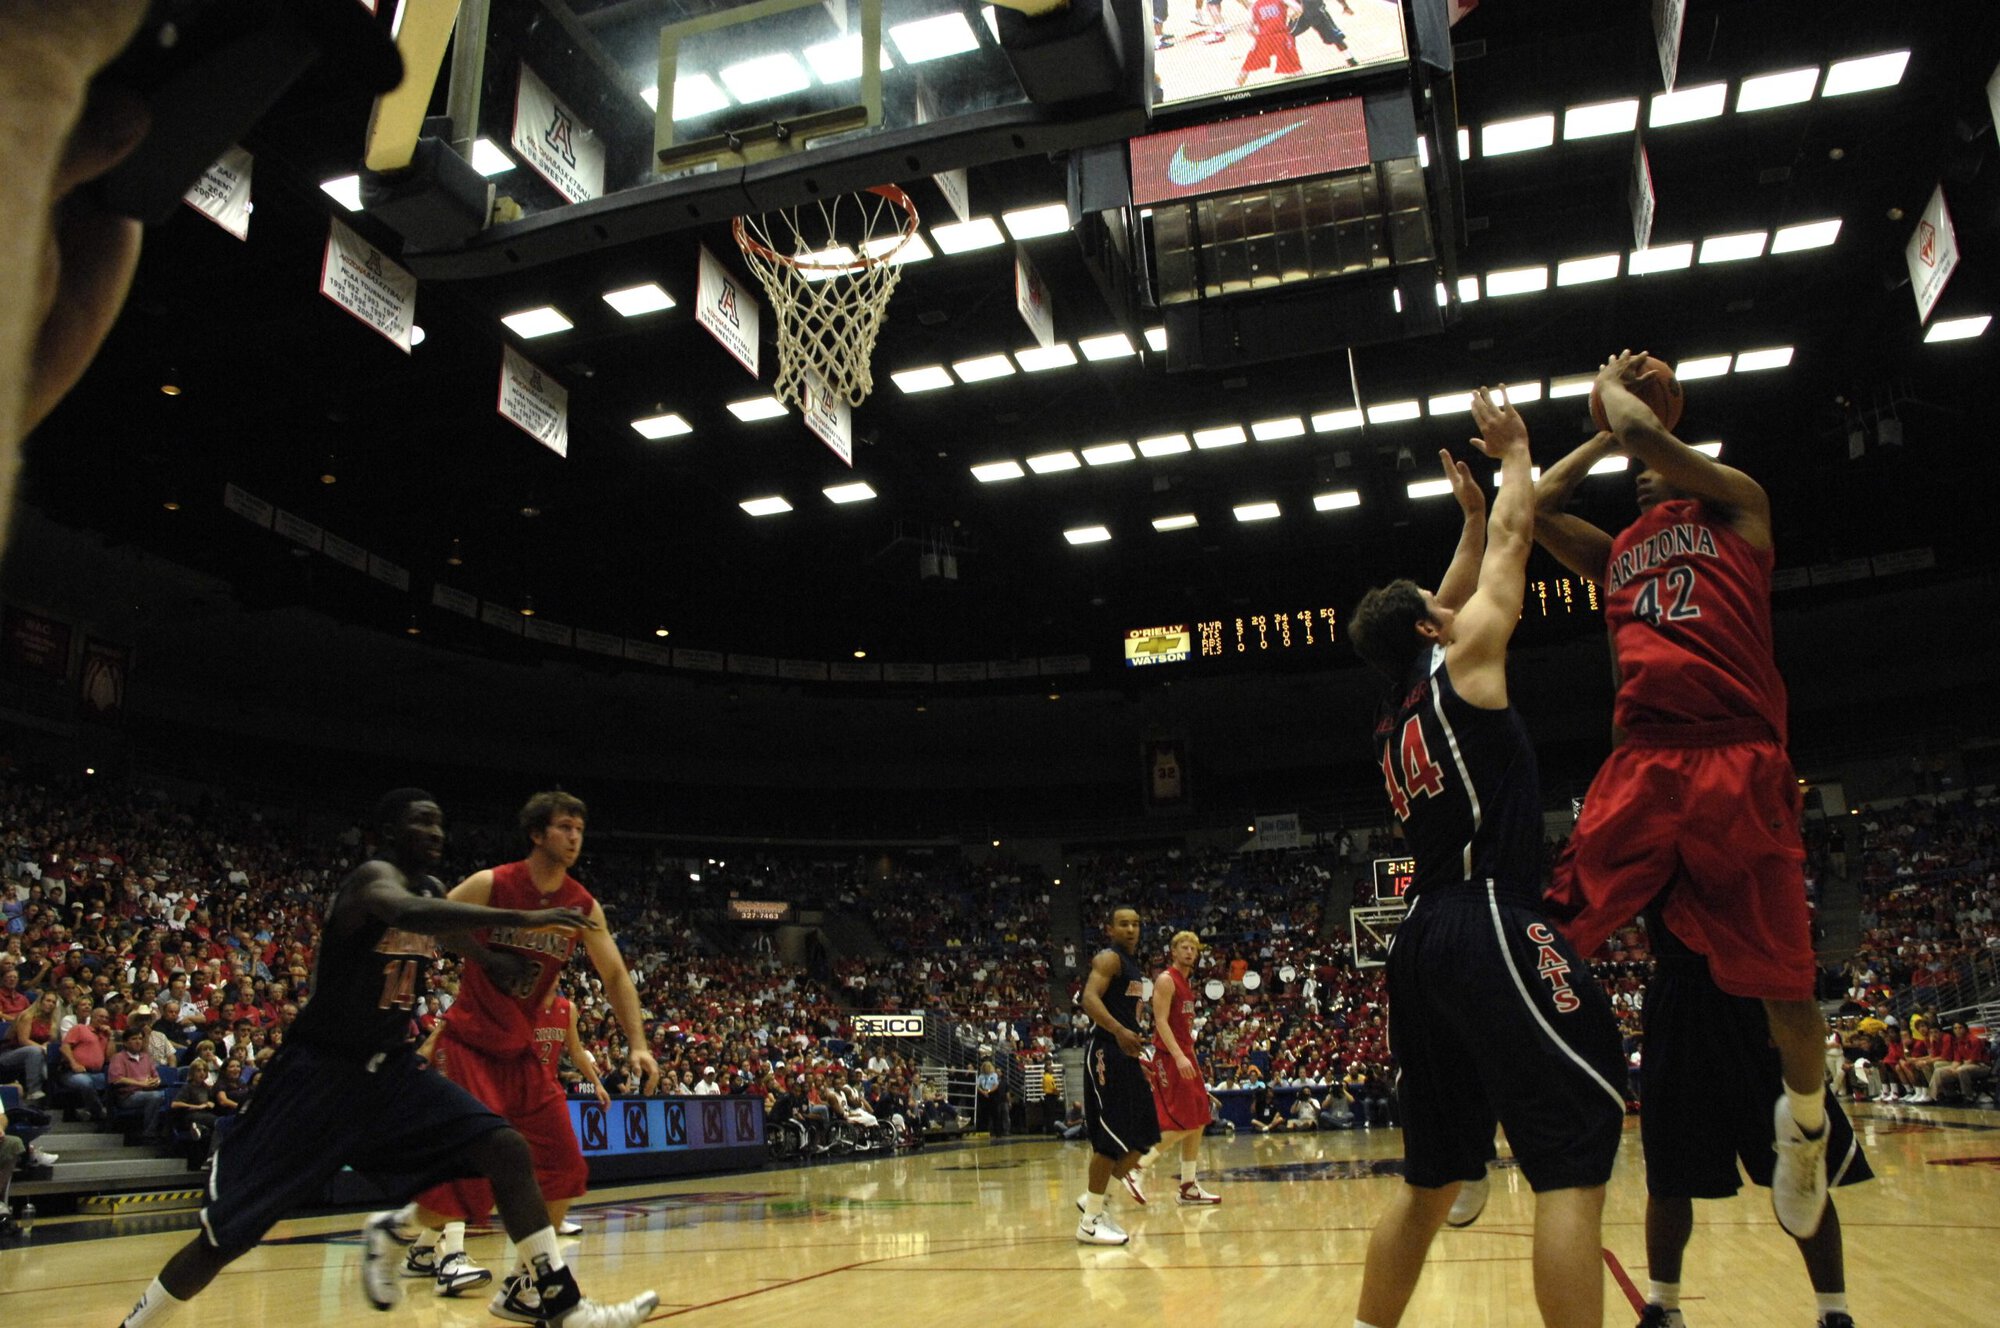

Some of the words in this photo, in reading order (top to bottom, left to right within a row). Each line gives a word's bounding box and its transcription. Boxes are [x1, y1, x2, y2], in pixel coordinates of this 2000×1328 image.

[1608, 523, 1720, 597] ARIZONA
[1632, 565, 1701, 626] 42
[1131, 653, 1187, 667] WATSON
[1526, 922, 1580, 1013] CATS
[853, 1019, 922, 1033] GEICO
[579, 1082, 596, 1094] POSS
